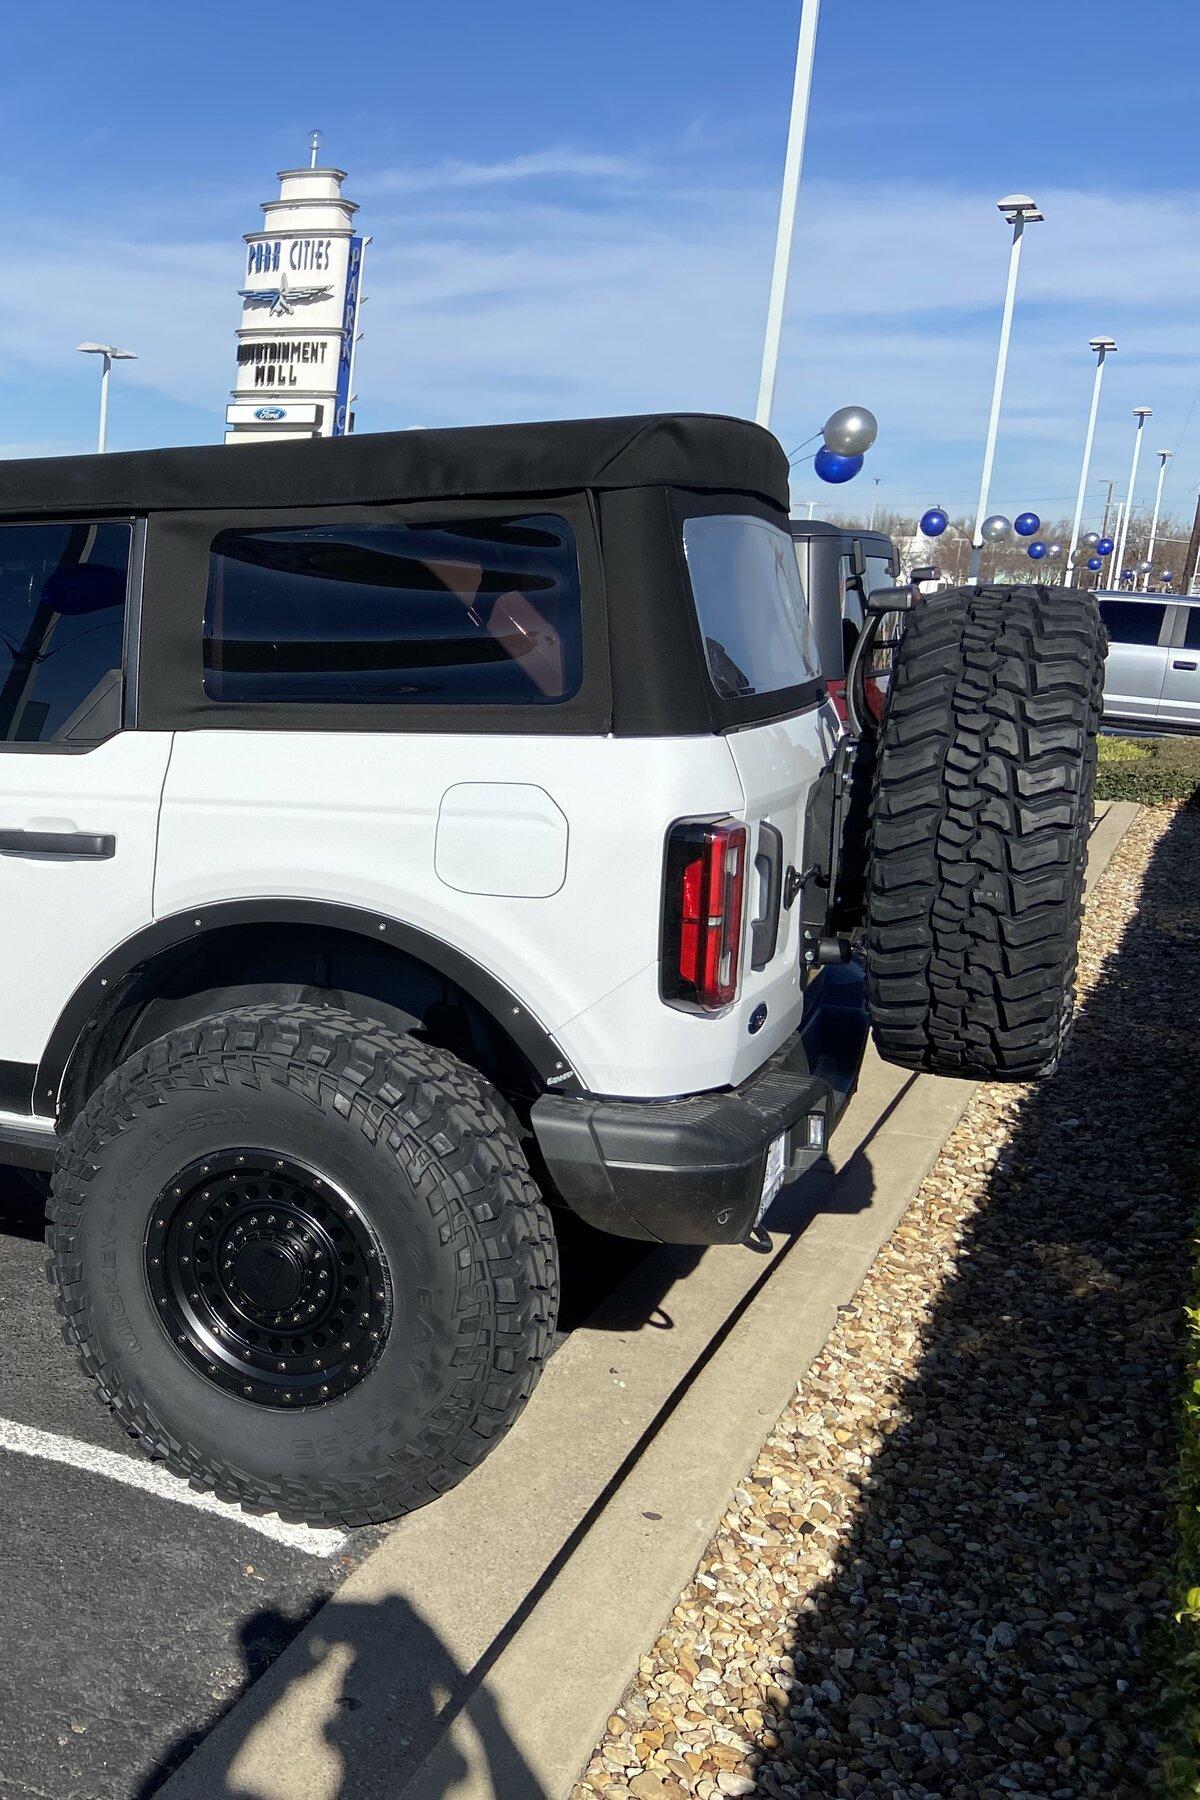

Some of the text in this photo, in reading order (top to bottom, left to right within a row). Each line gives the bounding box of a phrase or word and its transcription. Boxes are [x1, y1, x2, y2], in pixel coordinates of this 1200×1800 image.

[289, 240, 331, 271] CITIES
[255, 365, 297, 387] MALL
[259, 408, 282, 419] Ford
